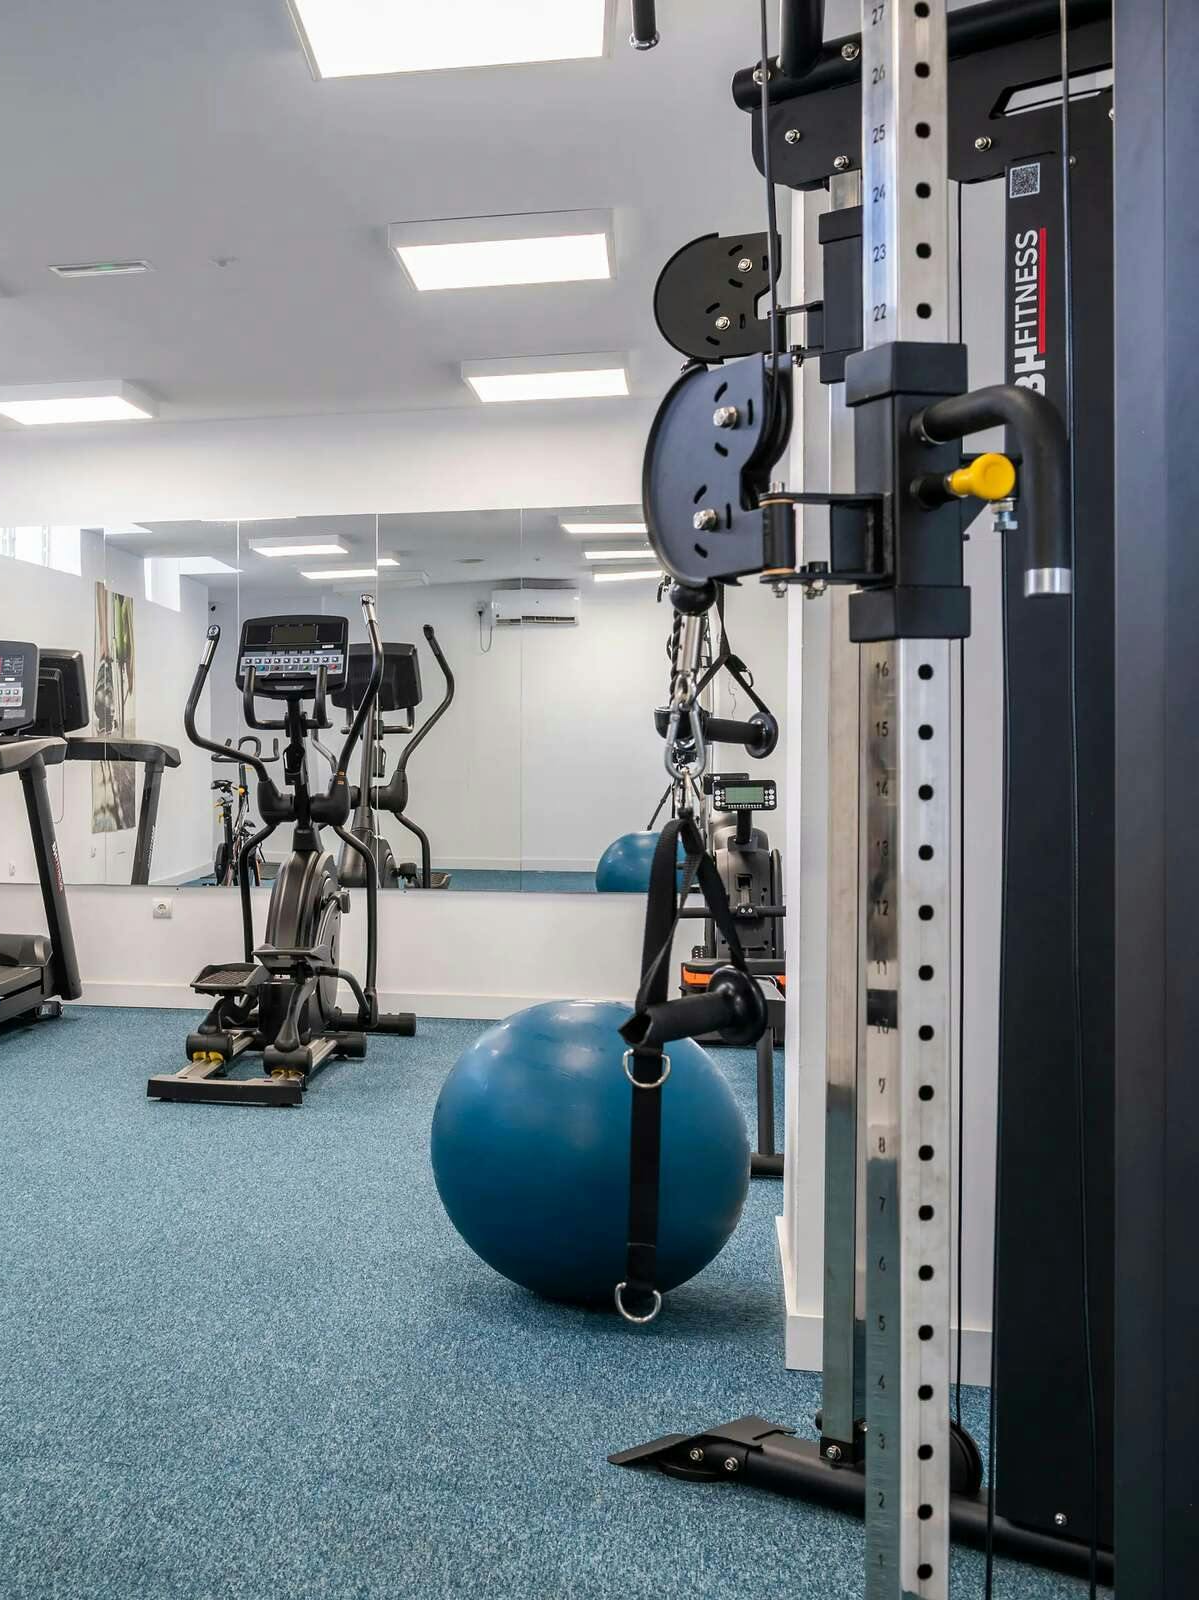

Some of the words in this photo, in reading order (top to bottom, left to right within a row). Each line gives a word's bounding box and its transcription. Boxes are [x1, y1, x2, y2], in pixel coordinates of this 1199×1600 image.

[872, 5, 884, 26] 27
[872, 65, 885, 85] 26
[873, 125, 886, 144] 25
[873, 184, 886, 203] 24
[873, 244, 886, 263] 23
[874, 303, 886, 322] 22
[875, 661, 889, 678] 16
[875, 721, 889, 738] 15
[875, 780, 889, 797] 14
[876, 840, 889, 857] 13
[876, 899, 889, 916] 12
[876, 959, 888, 976] 11
[878, 1078, 886, 1094] 9
[878, 1136, 886, 1154] 8
[879, 1196, 887, 1213] 7
[878, 1256, 887, 1272] 6
[878, 1315, 886, 1332] 5
[878, 1374, 886, 1391] 4
[878, 1432, 886, 1450] 3
[878, 1491, 885, 1509] 2
